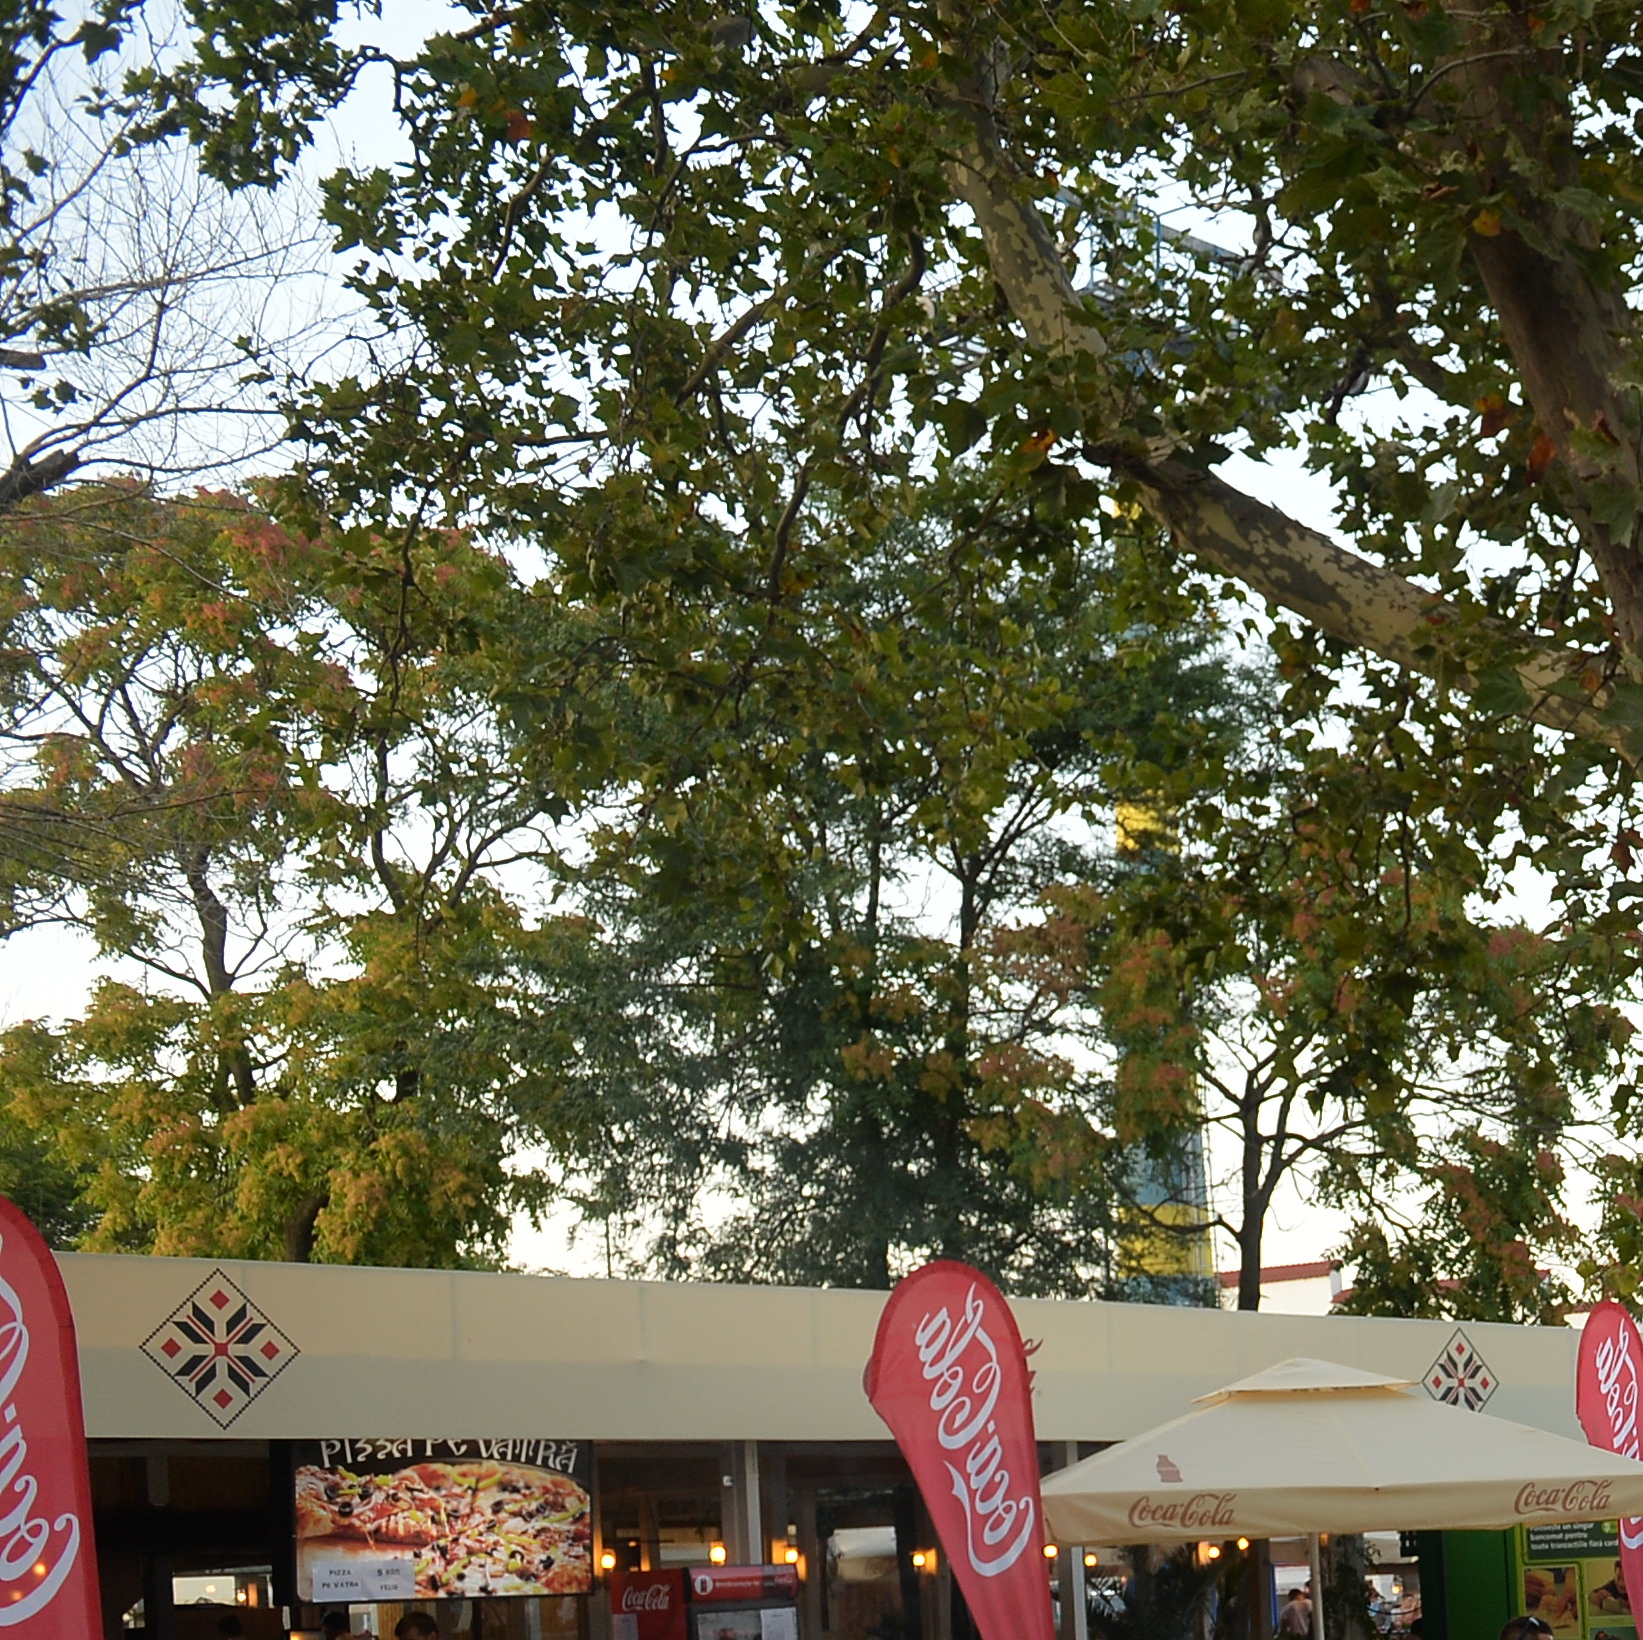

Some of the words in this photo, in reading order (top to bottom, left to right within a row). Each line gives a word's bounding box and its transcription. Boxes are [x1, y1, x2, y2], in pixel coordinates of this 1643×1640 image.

[1127, 1492, 1238, 1529] Coca-Cola
[1514, 1479, 1614, 1517] Coca-Cola
[328, 1569, 352, 1577] PIZZA
[622, 1584, 671, 1611] Coca-Cola
